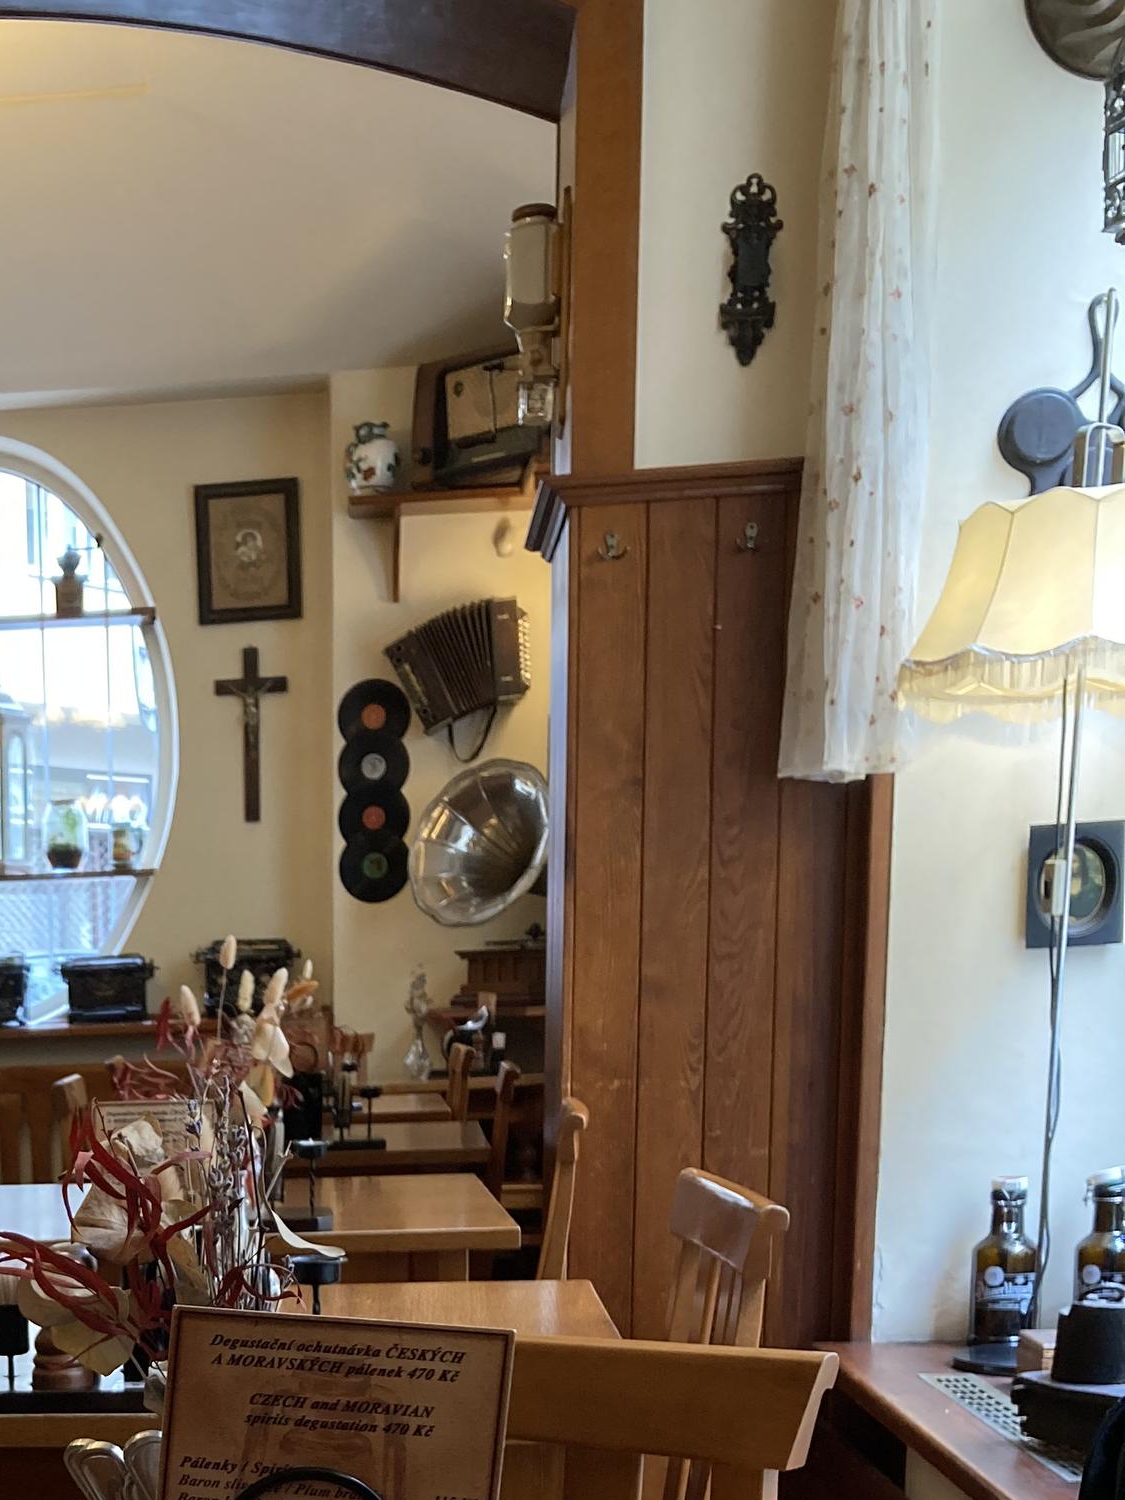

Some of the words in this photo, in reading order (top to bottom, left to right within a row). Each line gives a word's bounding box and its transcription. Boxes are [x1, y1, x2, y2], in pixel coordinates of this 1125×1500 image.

[210, 1334, 295, 1350] Degustační
[297, 1341, 381, 1358] ochutnávka
[385, 1343, 467, 1364] ČESKÝCH
[211, 1354, 223, 1365] A
[227, 1354, 342, 1374] MORAVSKÝCH
[345, 1364, 403, 1378] pálenek
[407, 1367, 434, 1380] 470
[438, 1369, 461, 1383] Kč
[249, 1392, 307, 1409] CZECH
[310, 1400, 340, 1412] and
[341, 1402, 435, 1418] MORAVIAN
[244, 1413, 290, 1426] spirits
[294, 1416, 379, 1433] degustation
[382, 1423, 410, 1436] 470
[412, 1424, 435, 1437] Kč
[179, 1456, 238, 1474] Pálenky
[178, 1474, 220, 1489] Baron
[295, 1484, 332, 1498] Plum
